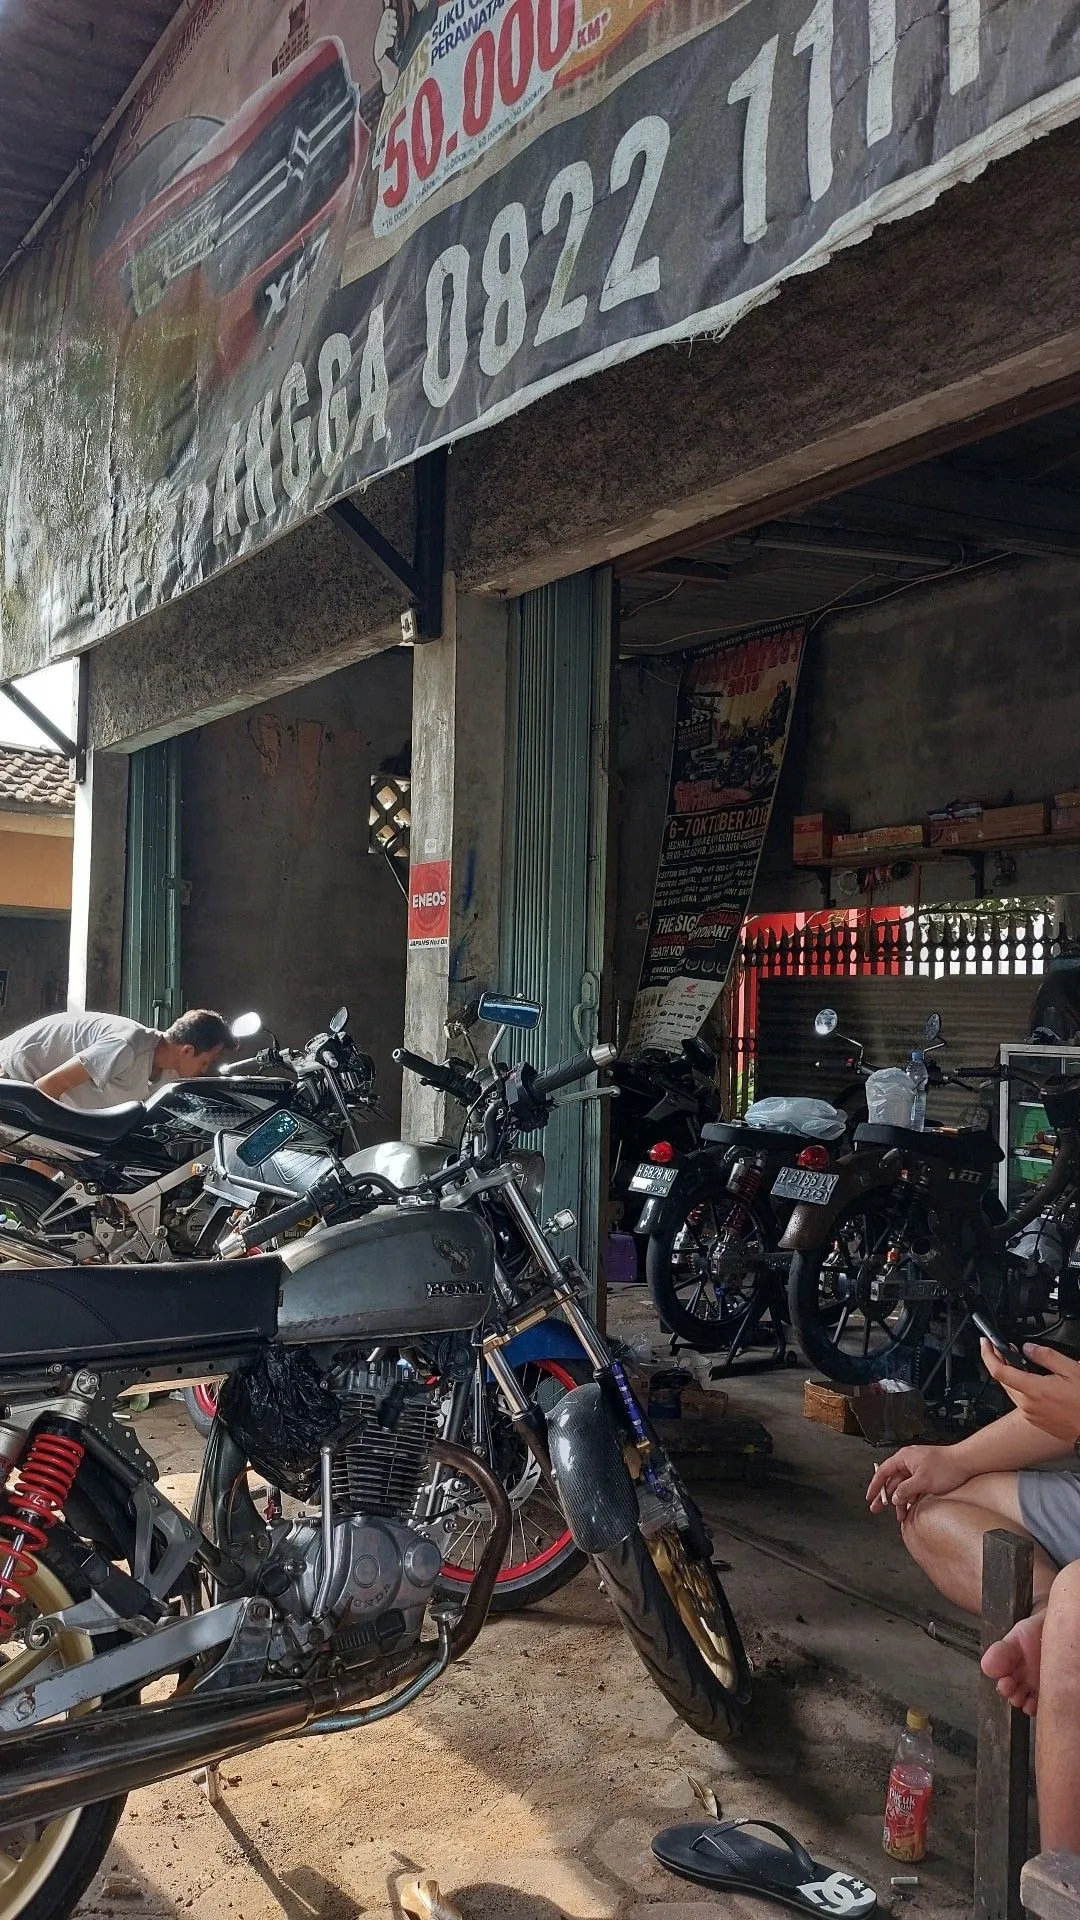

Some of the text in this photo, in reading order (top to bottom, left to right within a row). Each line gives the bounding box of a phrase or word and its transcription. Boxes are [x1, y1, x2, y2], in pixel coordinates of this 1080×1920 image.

[431, 0, 465, 44] SUKU
[431, 0, 506, 66] PERAWATA
[383, 0, 576, 208] 50.000
[422, 114, 671, 408] 0822
[412, 891, 447, 909] ENEOS
[426, 1281, 485, 1297] HONDA
